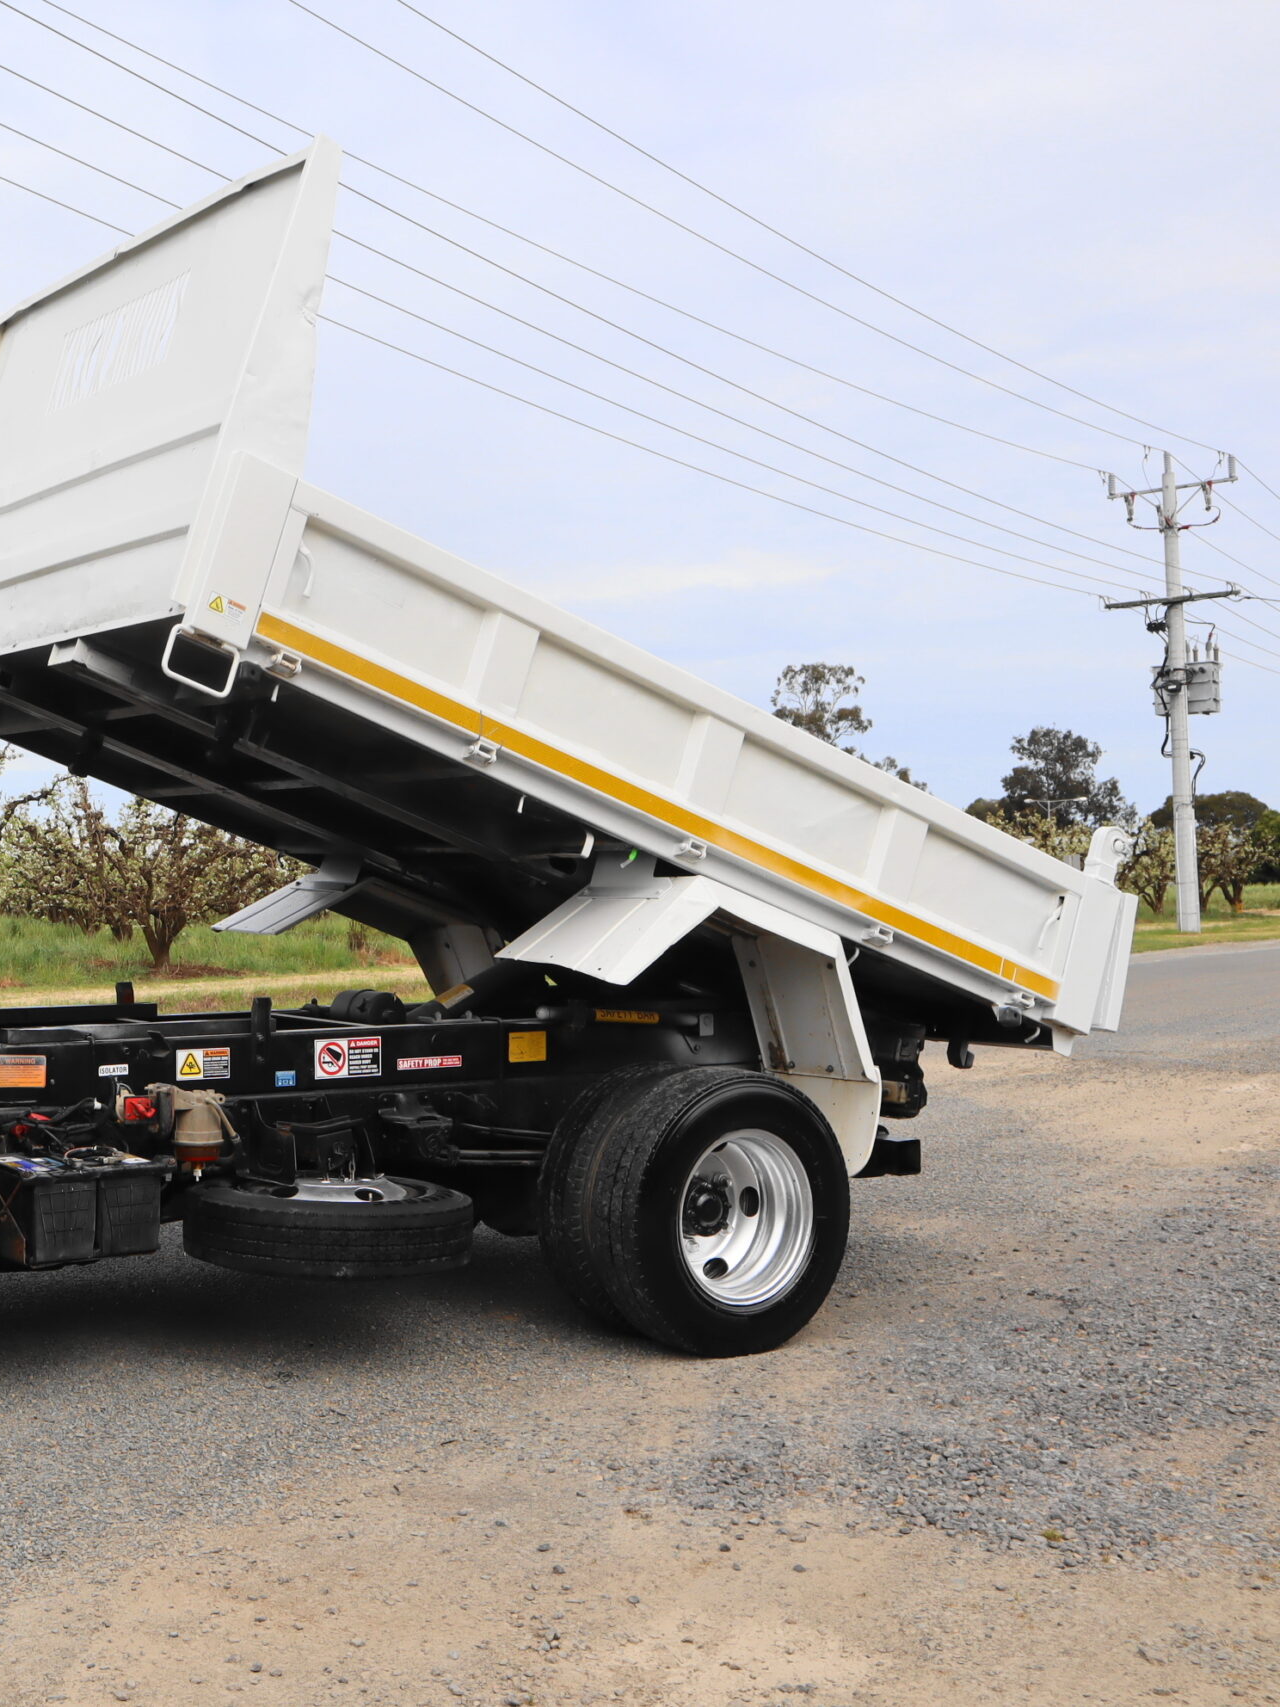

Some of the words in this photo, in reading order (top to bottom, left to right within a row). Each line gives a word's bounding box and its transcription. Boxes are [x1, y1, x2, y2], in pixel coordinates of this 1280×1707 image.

[398, 1059, 424, 1069] SAFETY
[424, 1058, 441, 1067] PROP
[99, 1066, 128, 1075] ISOLATOR
